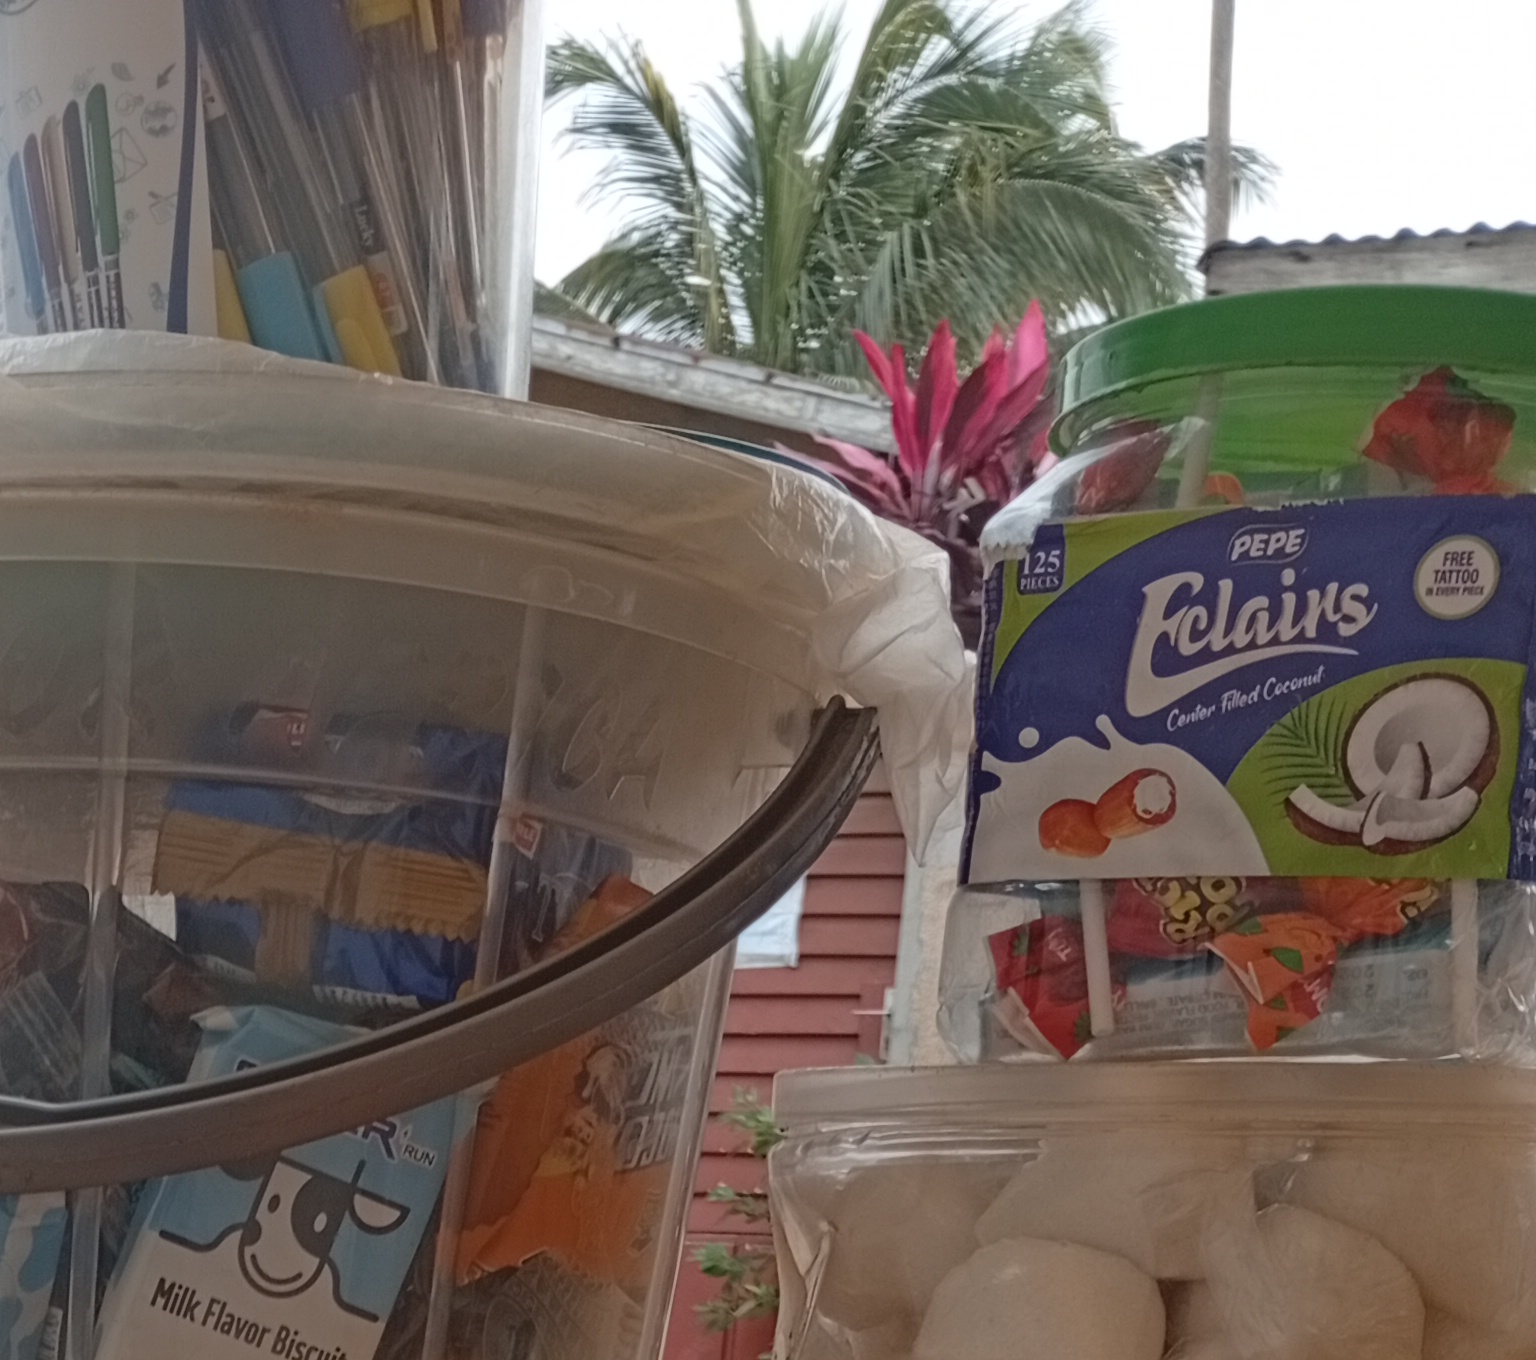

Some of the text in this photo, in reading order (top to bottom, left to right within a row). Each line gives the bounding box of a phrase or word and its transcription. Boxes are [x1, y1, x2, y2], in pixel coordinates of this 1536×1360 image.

[1230, 527, 1306, 562] PEPE
[1022, 549, 1062, 575] 125
[1442, 550, 1475, 567] FREE
[1019, 575, 1060, 591] PIECES
[1433, 568, 1480, 585] TATTOO
[1425, 585, 1485, 597] IN EVERY PIECE
[1125, 568, 1379, 718] Eclairs
[1166, 663, 1326, 732] Center Filled Coconut
[400, 1141, 435, 1166] RUN
[148, 1276, 198, 1323] Milk
[201, 1296, 273, 1349] Flavor
